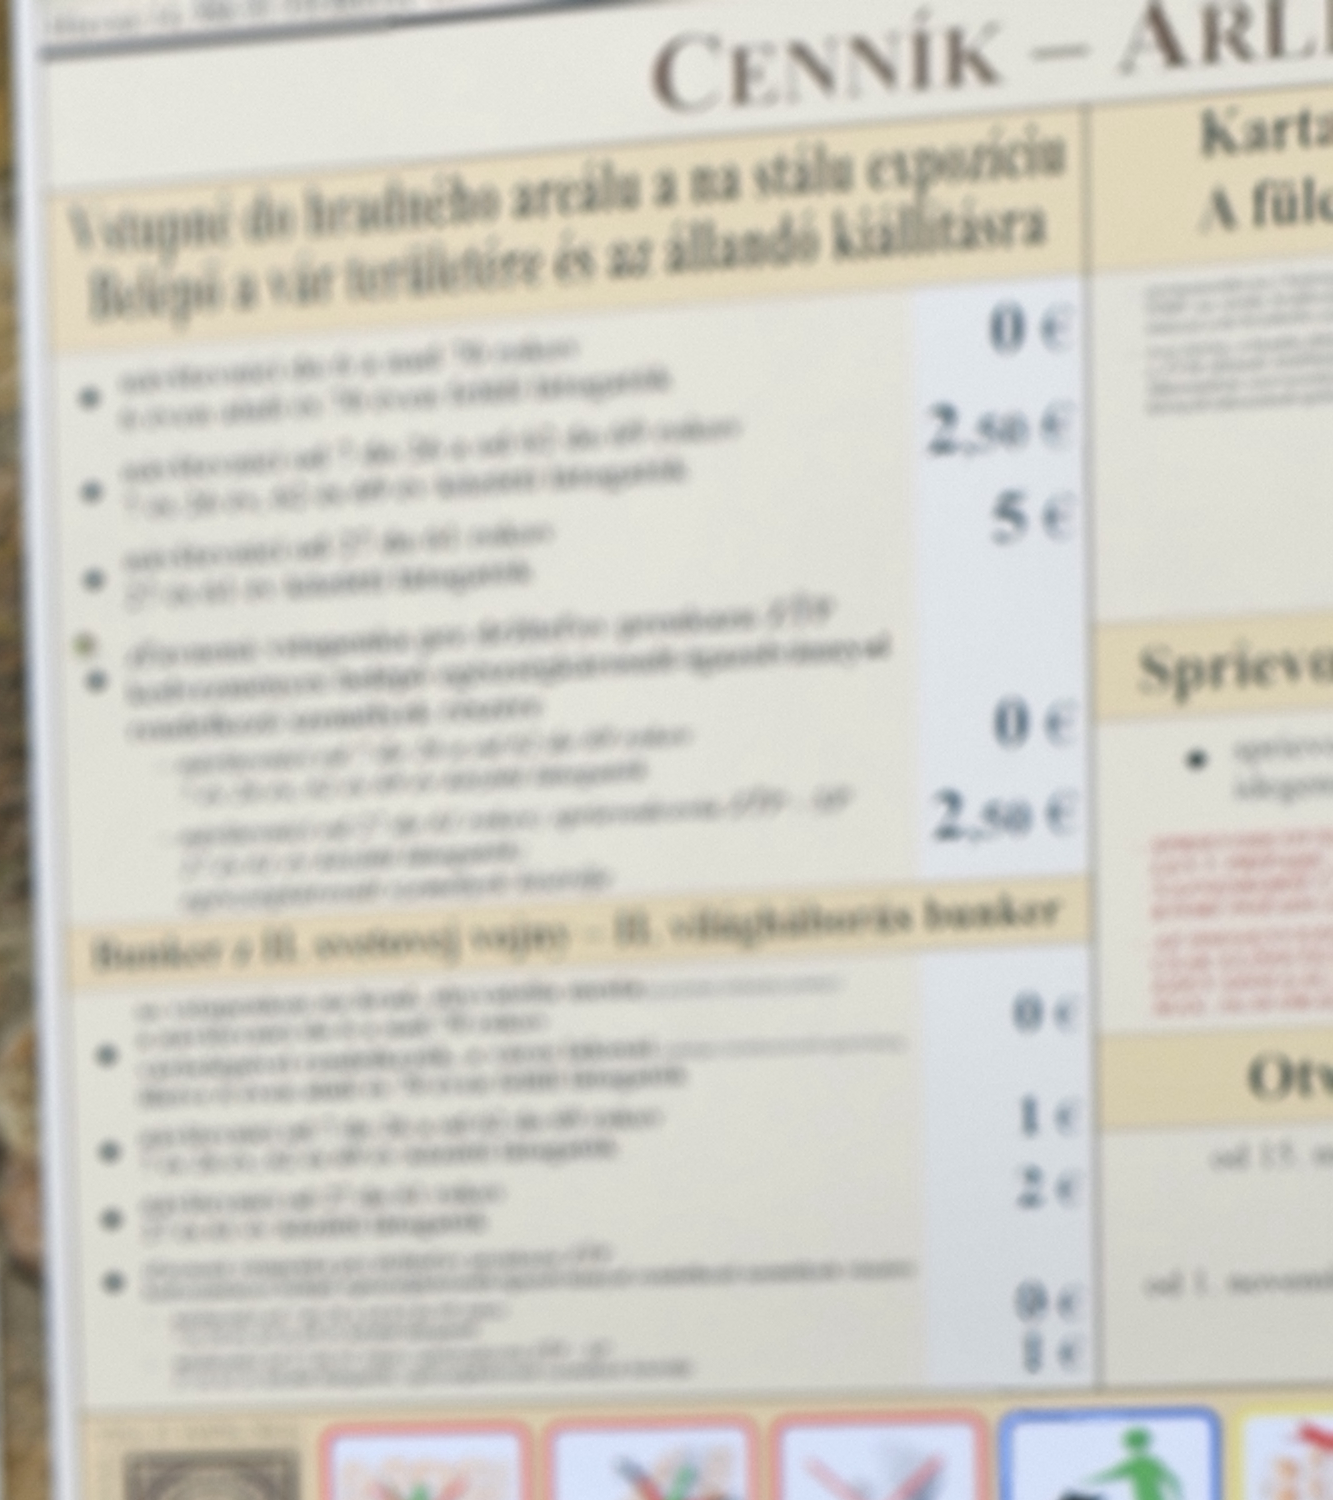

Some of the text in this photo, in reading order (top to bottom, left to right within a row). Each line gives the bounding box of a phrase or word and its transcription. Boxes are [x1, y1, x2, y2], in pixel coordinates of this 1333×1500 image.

[649, 8, 1002, 115] CENNÍK
[988, 299, 1028, 356] 0
[991, 489, 1029, 546] 5
[992, 694, 1031, 750] 0
